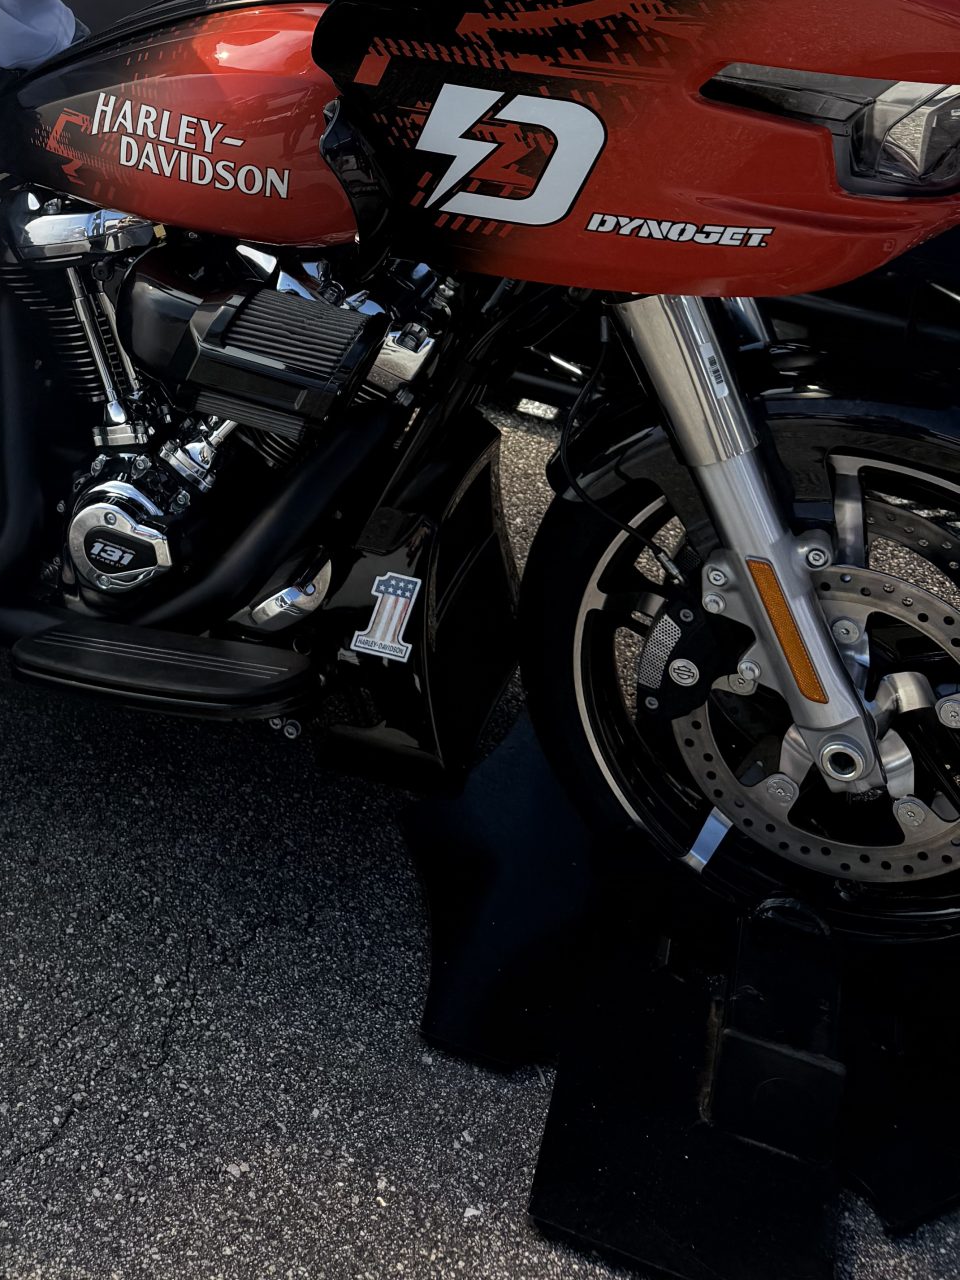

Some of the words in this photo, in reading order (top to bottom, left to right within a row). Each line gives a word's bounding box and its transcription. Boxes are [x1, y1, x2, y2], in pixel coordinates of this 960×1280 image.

[91, 92, 245, 153] HARLEY-
[120, 135, 290, 199] DAVIDSON
[90, 542, 134, 566] 131
[357, 638, 406, 655] HARLEY-DAVIDSON
